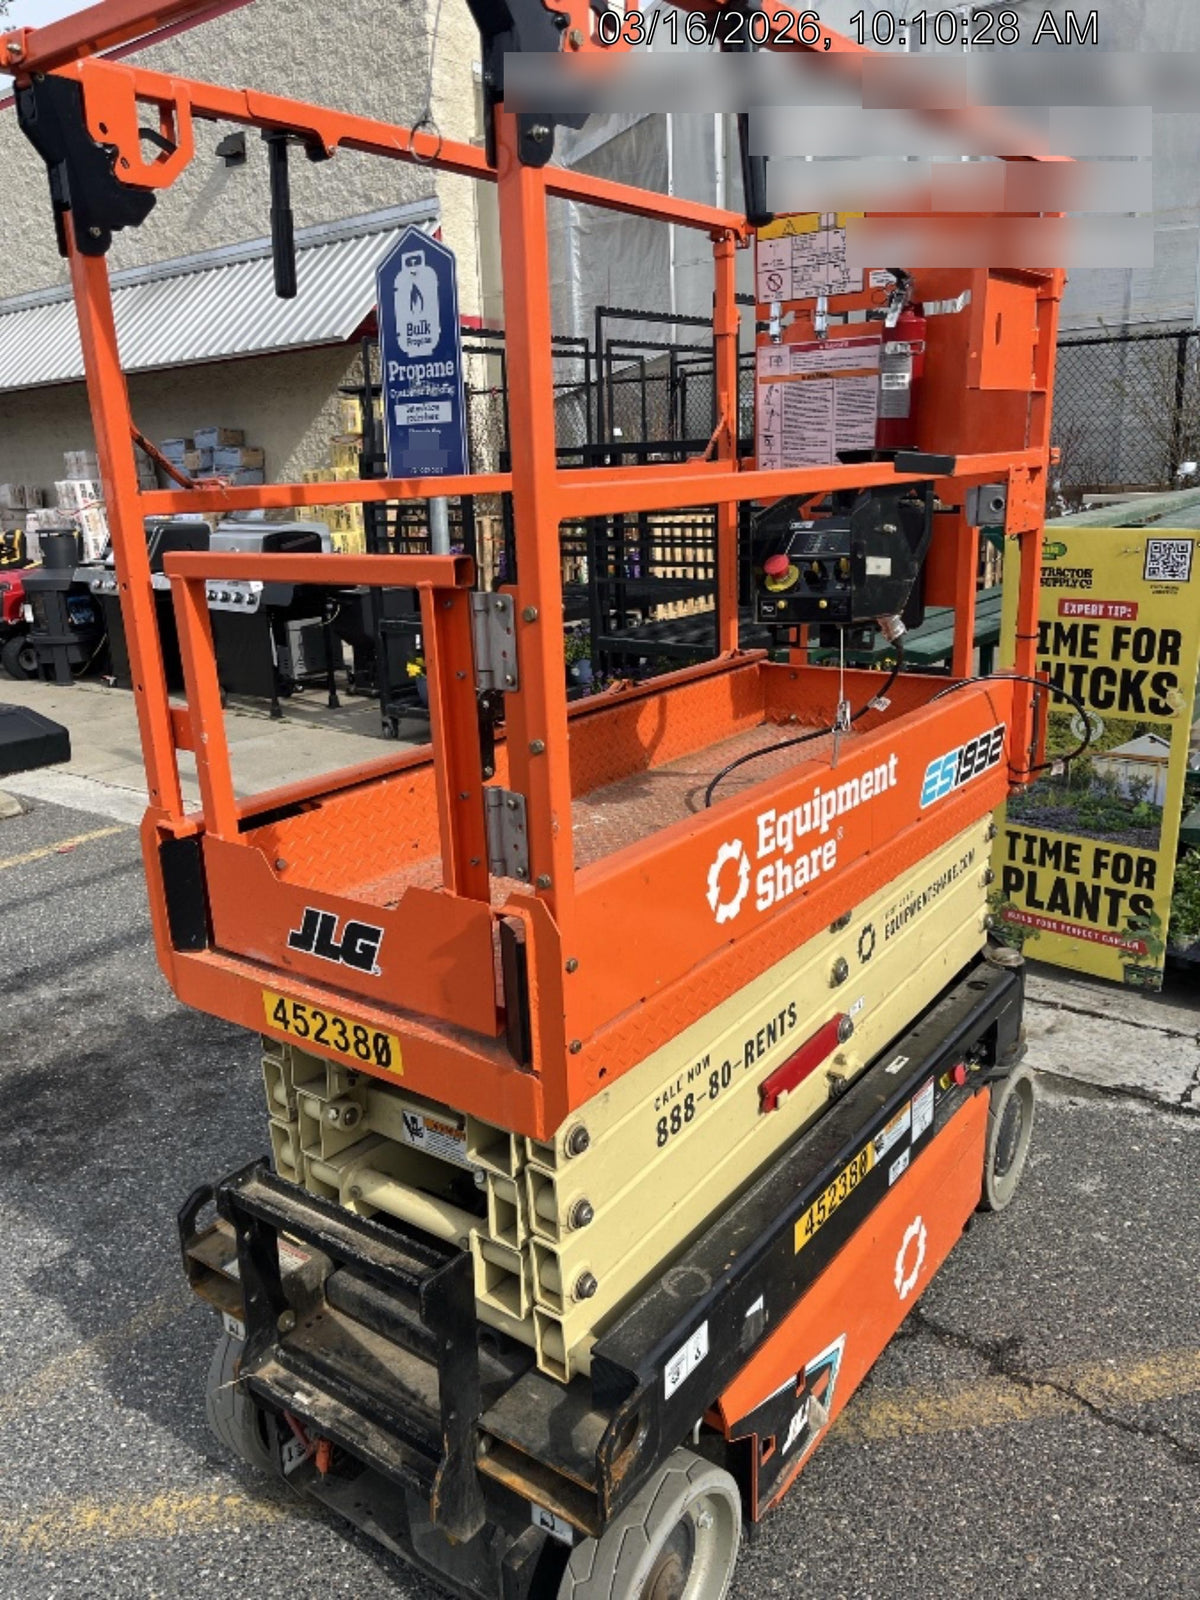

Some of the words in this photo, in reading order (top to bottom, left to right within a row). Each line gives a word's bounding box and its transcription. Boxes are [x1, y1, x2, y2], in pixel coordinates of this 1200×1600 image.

[406, 319, 431, 336] Bulk
[388, 358, 454, 386] Propane
[1040, 567, 1093, 579] TRACTOR
[1063, 602, 1104, 617] EXPERT
[1107, 605, 1132, 618] TIP:
[1036, 620, 1100, 659] IME
[1111, 625, 1182, 666] FOR
[1042, 661, 1179, 716] HICKS
[920, 722, 1006, 809] ES1932
[756, 753, 898, 858] Equipment
[1005, 830, 1082, 875] TIME
[1092, 847, 1157, 890] FOR
[884, 848, 976, 941] EQUIPMENTSHARE.COM
[1002, 865, 1155, 932] PLANTS
[287, 906, 384, 976] JLG
[1061, 922, 1099, 940] PERFECT
[272, 997, 392, 1069] 452380
[654, 1072, 684, 1112] CALL
[687, 1053, 711, 1083] NOW
[656, 1001, 797, 1148] 888-80-RENTS
[804, 1147, 869, 1237] 452380
